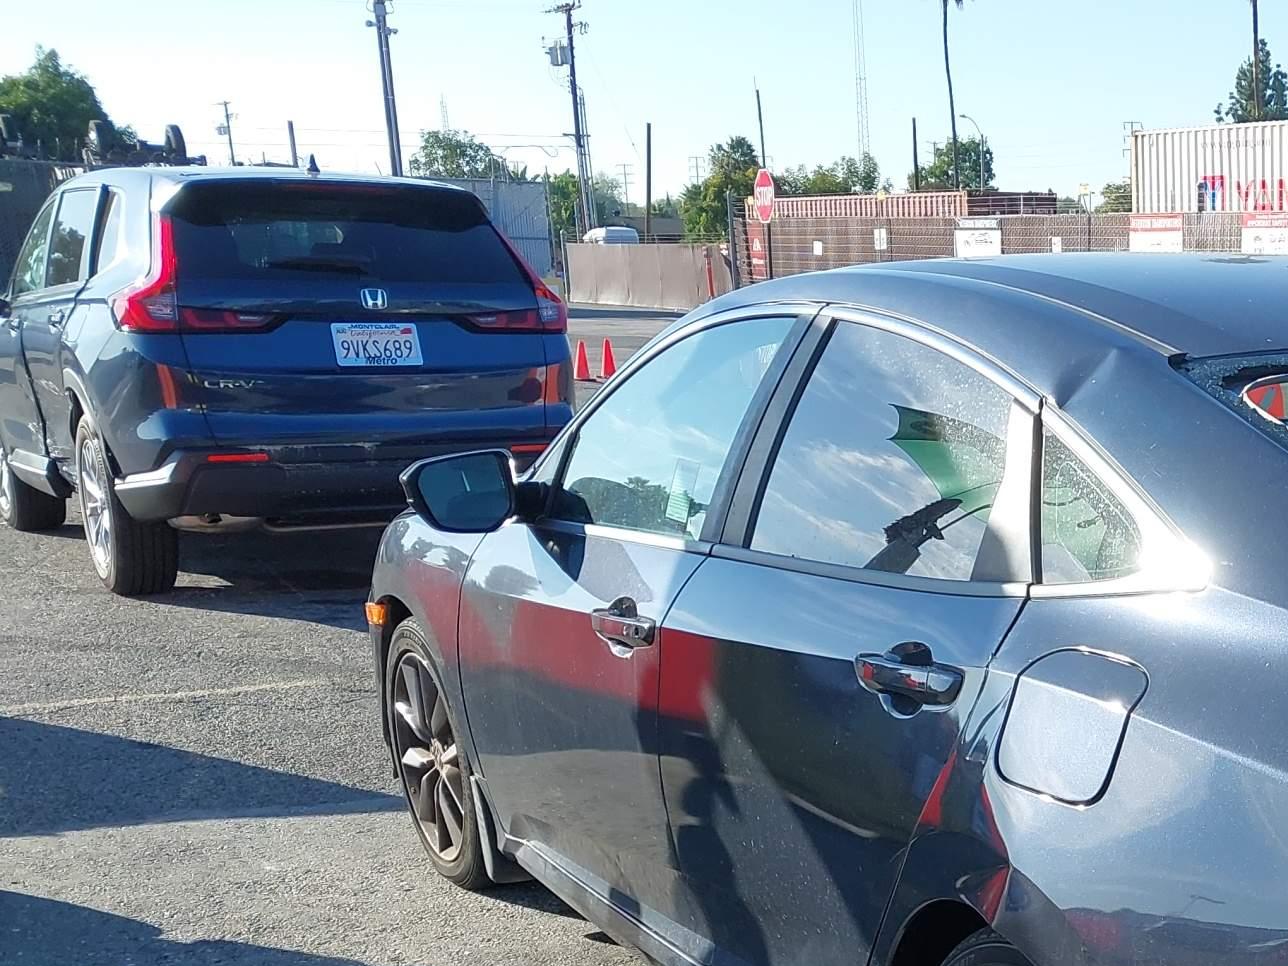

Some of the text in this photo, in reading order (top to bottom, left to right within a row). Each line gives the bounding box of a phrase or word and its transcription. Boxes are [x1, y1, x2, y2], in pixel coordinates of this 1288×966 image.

[756, 186, 774, 205] STOP
[341, 340, 412, 359] 9VKS689
[366, 356, 398, 365] Metro
